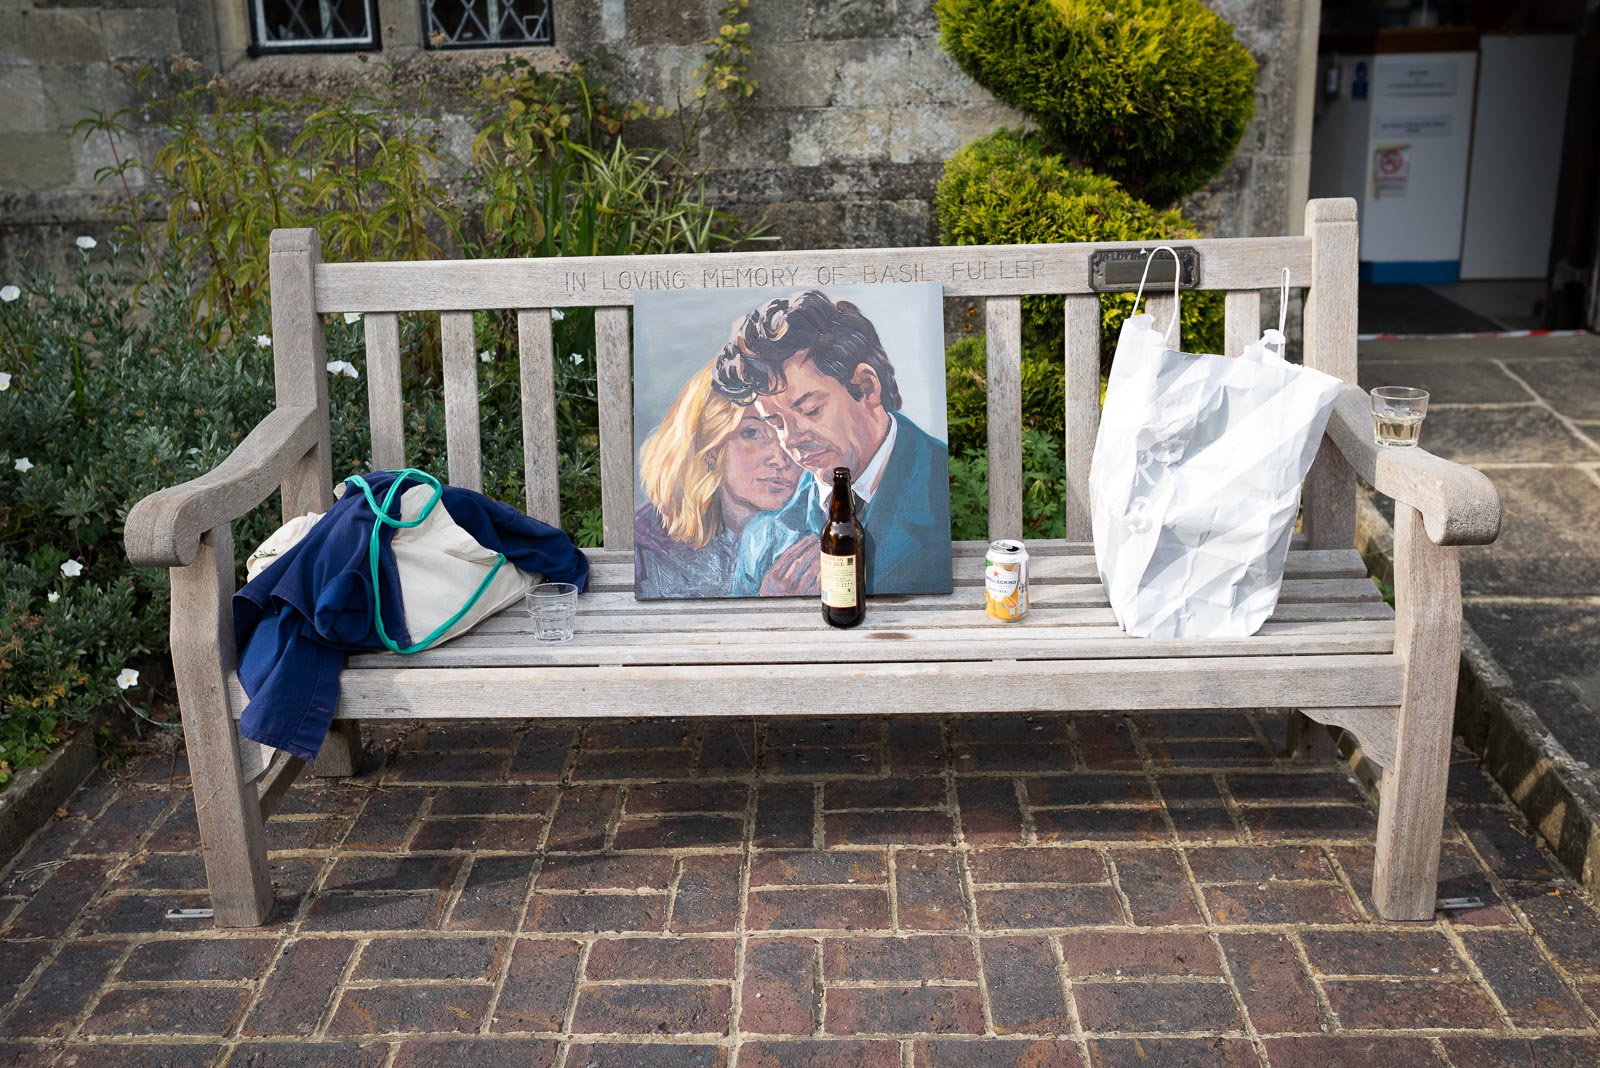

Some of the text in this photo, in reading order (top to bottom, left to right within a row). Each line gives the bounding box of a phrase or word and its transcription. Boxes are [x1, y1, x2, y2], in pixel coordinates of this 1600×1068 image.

[565, 260, 1045, 291] IN LOVING MEMORY OF BASIL FULLER
